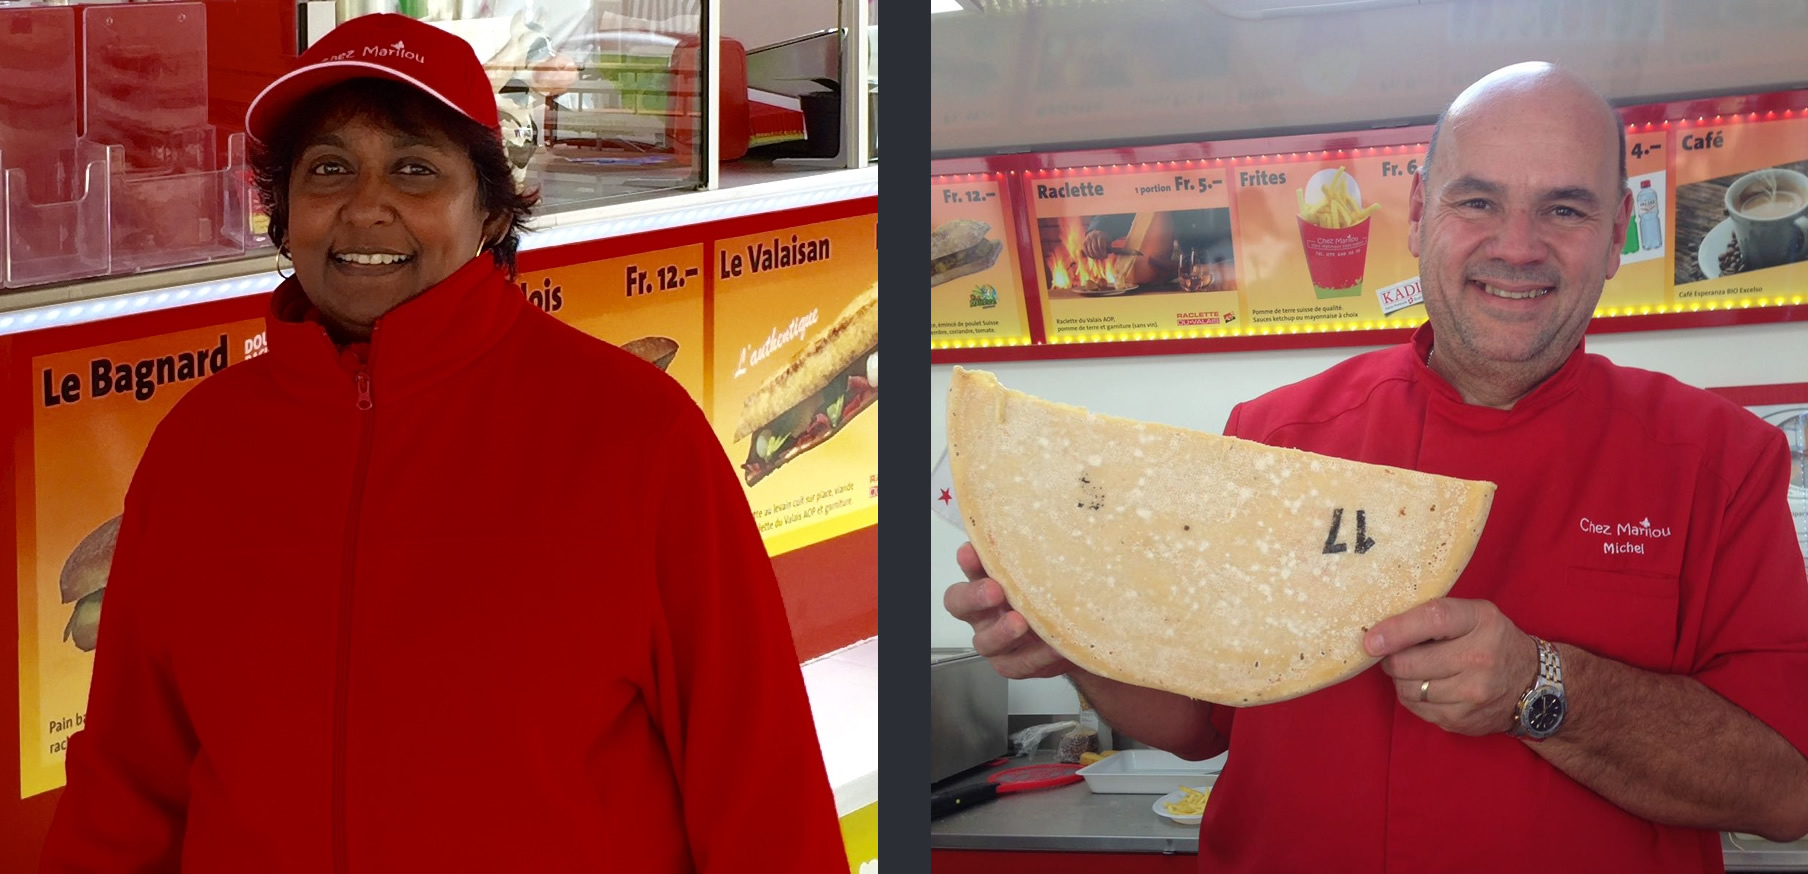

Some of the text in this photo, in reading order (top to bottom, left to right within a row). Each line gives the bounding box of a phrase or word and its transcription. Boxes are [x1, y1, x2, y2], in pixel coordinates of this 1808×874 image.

[362, 45, 425, 64] Marilou
[1681, 131, 1724, 151] Café
[1382, 161, 1403, 176] Fr.
[1140, 184, 1171, 196] portion
[1174, 176, 1196, 191] Fr.
[1239, 169, 1287, 187] Frites
[943, 189, 962, 204] Fr.
[1037, 182, 1104, 199] Raclette
[719, 235, 831, 280] Le Valaisan
[625, 265, 653, 297] Fr.
[1382, 281, 1422, 304] KADI
[1694, 289, 1726, 298] Esperanza
[1726, 287, 1738, 295] BIO
[1739, 286, 1763, 294] Excelso
[1304, 313, 1337, 321] mayonnaise
[1106, 323, 1131, 331] garniture
[43, 334, 229, 407] Le Bagnard
[1322, 507, 1376, 555] 17
[1580, 517, 1671, 538] Chez Marilou
[1603, 541, 1645, 555] Michel
[49, 717, 73, 734] Pain
[50, 736, 70, 754] rac
